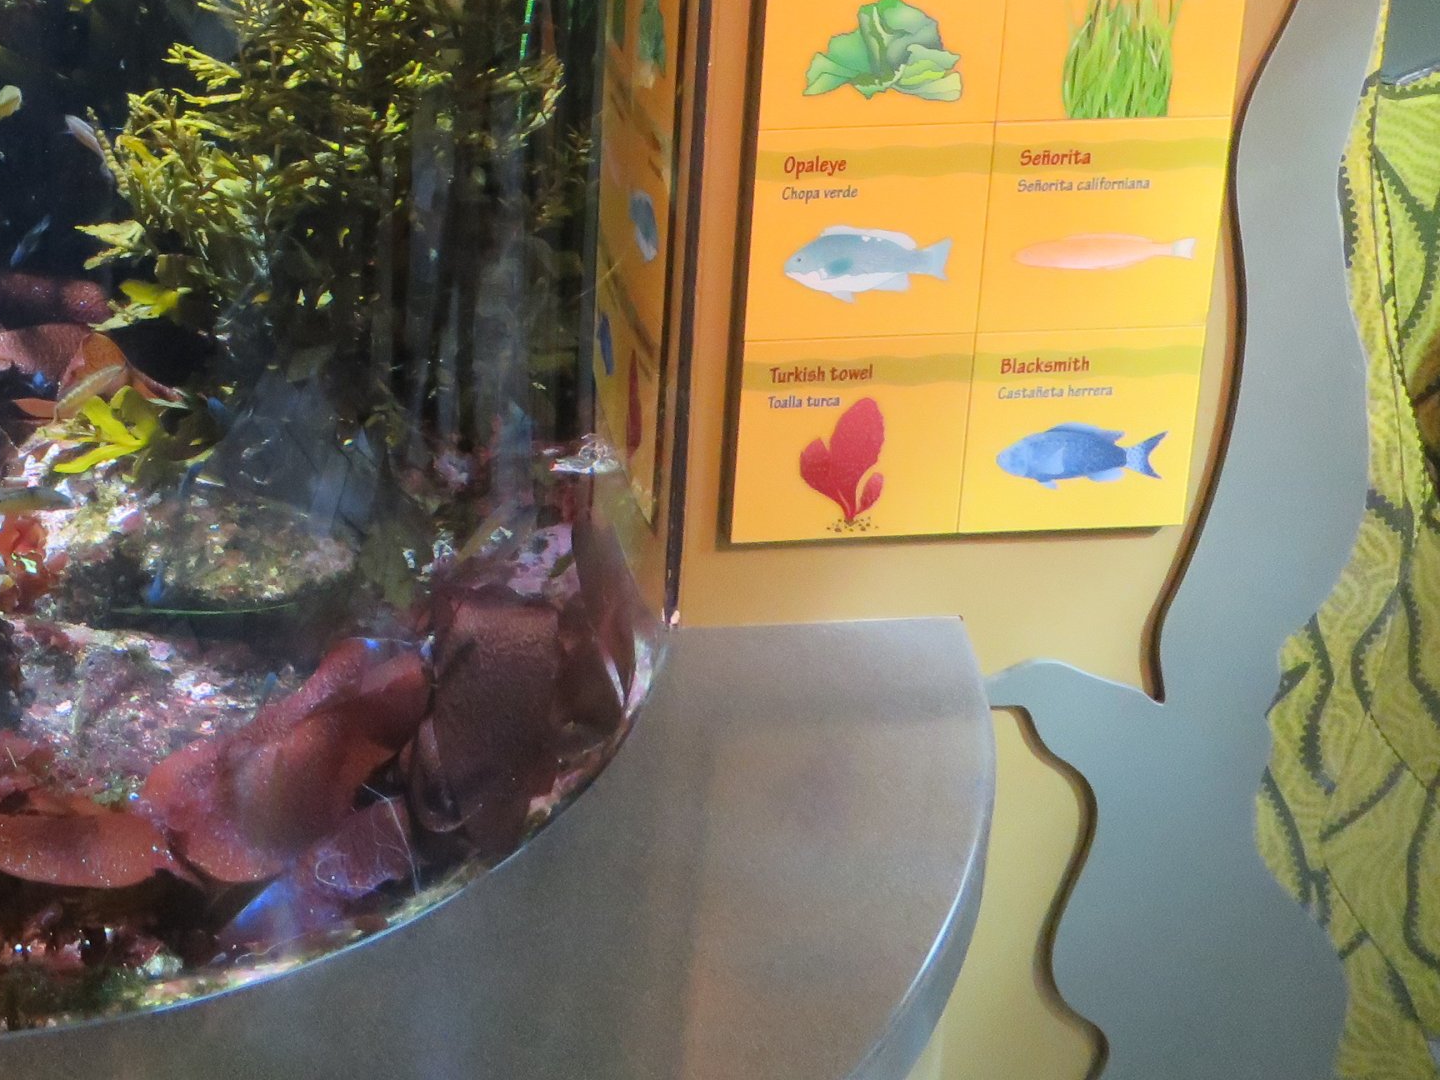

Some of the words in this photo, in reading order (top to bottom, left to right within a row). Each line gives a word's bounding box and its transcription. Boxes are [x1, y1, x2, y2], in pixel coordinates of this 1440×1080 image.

[1020, 150, 1091, 166] Señorita
[784, 156, 847, 179] Opaleye
[1018, 179, 1072, 192] Señorita
[1077, 178, 1149, 191] californiana
[782, 187, 819, 204] Chopa
[824, 185, 858, 198] verde
[770, 366, 825, 383] Turkish
[830, 364, 873, 381] towel
[1001, 356, 1089, 374] Blacksmith
[998, 386, 1063, 399] Castañeta
[1068, 385, 1113, 397] herrera
[768, 395, 802, 408] Toalla
[807, 396, 840, 407] turca
